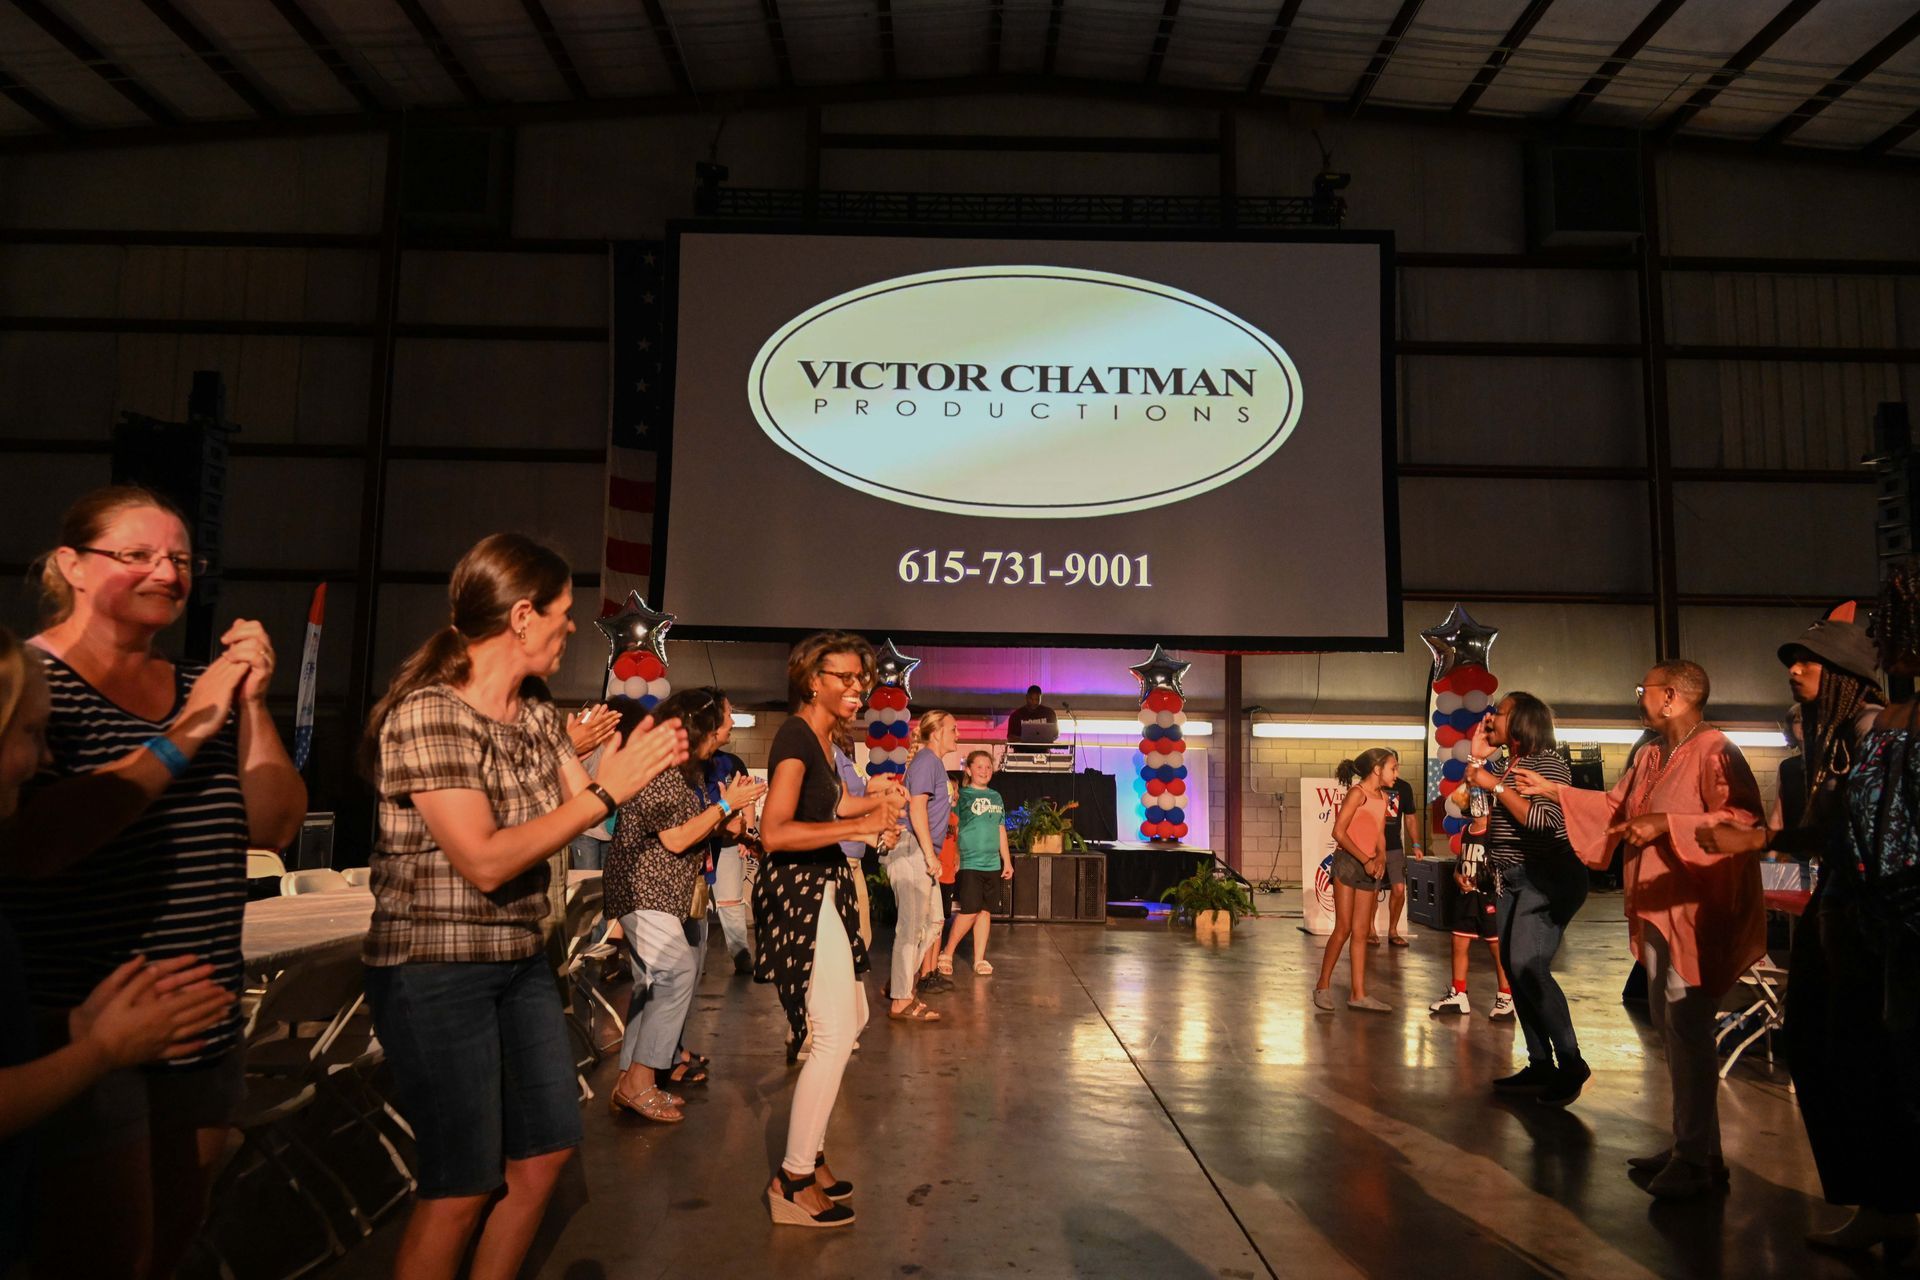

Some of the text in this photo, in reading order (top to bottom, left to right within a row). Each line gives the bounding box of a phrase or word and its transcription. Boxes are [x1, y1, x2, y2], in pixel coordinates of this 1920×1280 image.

[797, 360, 1257, 397] VICTOR CHATMAN
[814, 398, 1250, 423] PRODUCTIONS
[898, 549, 1153, 587] 615-731-9001
[1319, 809, 1331, 823] of
